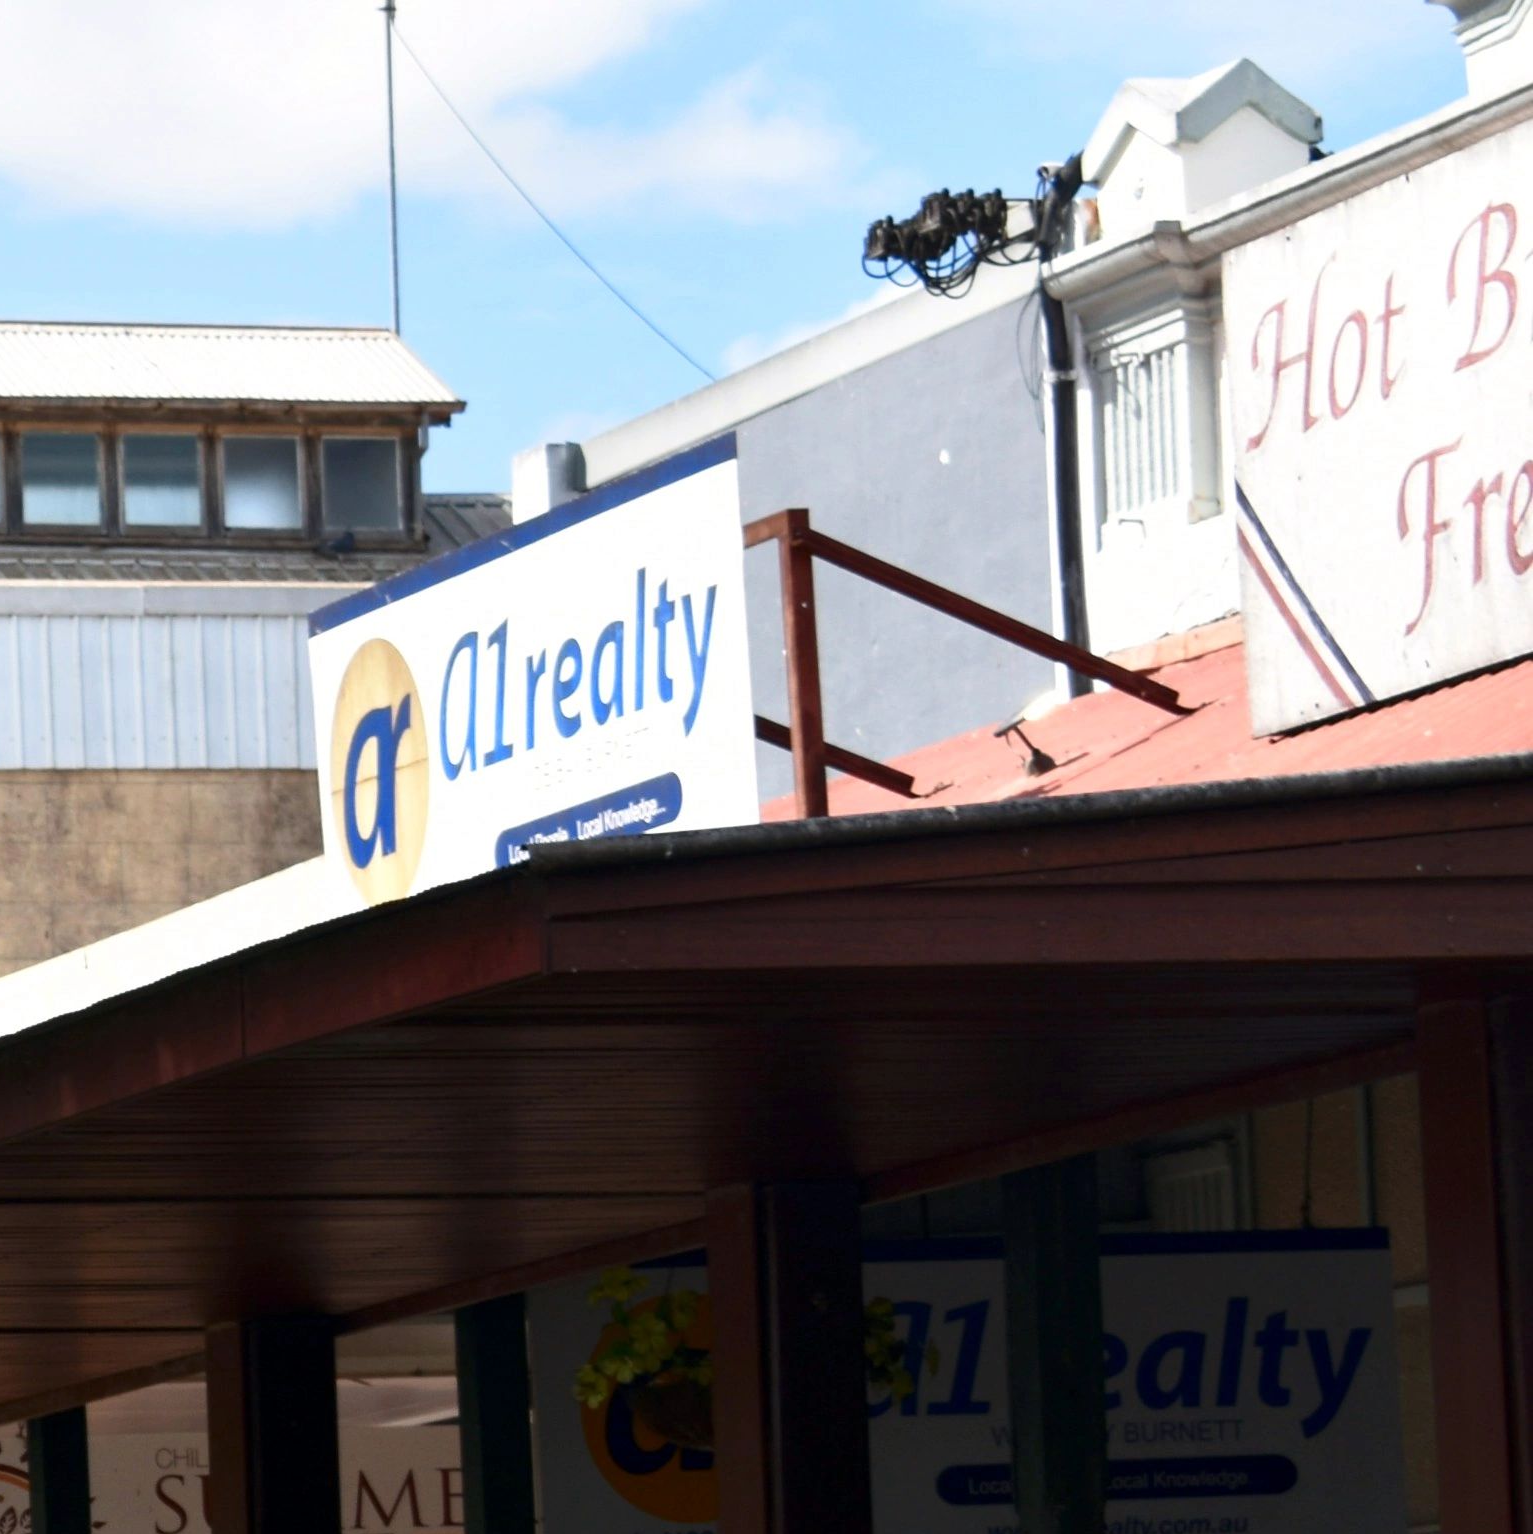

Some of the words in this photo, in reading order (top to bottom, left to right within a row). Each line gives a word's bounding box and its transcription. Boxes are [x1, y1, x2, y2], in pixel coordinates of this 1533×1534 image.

[1244, 250, 1407, 453] Hot
[1446, 200, 1533, 375] B
[1397, 434, 1533, 637] Fre
[576, 812, 604, 840] Local
[1123, 1419, 1244, 1444] BURNETT
[155, 1447, 208, 1470] CHIL
[968, 1477, 1013, 1496] Loca
[1106, 1472, 1149, 1491] ocal
